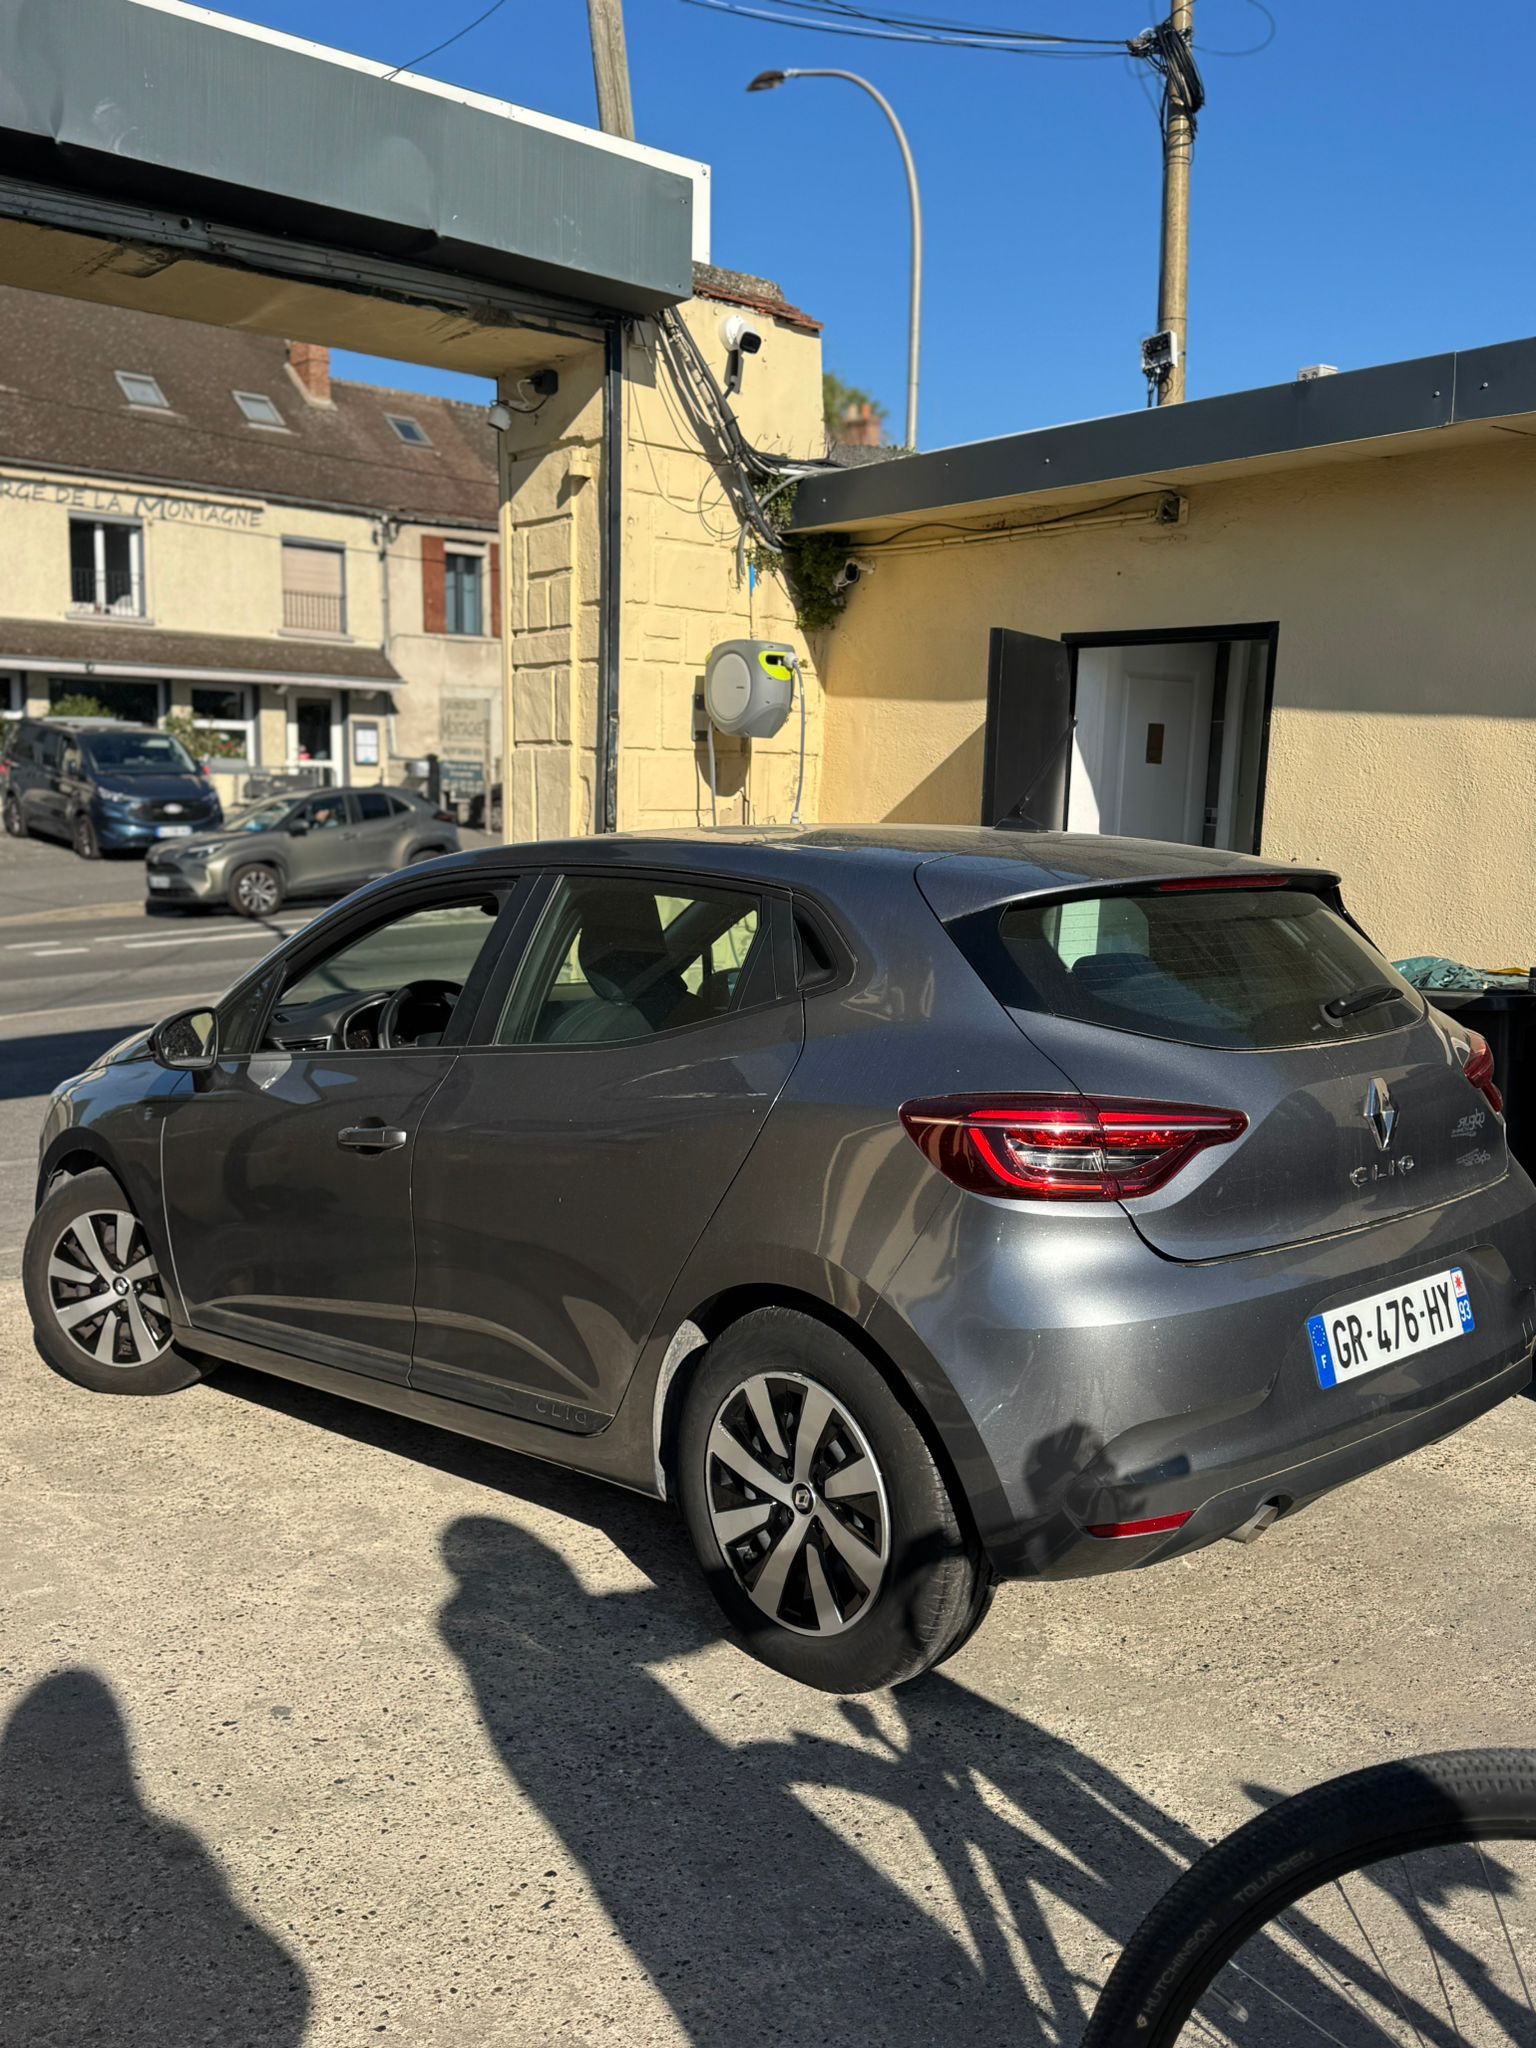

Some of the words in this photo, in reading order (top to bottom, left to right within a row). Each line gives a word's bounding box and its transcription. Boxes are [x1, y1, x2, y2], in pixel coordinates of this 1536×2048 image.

[56, 486, 84, 506] DE
[94, 491, 122, 512] LA
[134, 496, 263, 527] MONTAGNE
[1349, 1155, 1415, 1188] CLIO
[1332, 1281, 1453, 1369] GR-476-HY
[1458, 1299, 1472, 1322] 93
[535, 1400, 587, 1426] CLIO
[1143, 1918, 1218, 2014] HUTCHINSON
